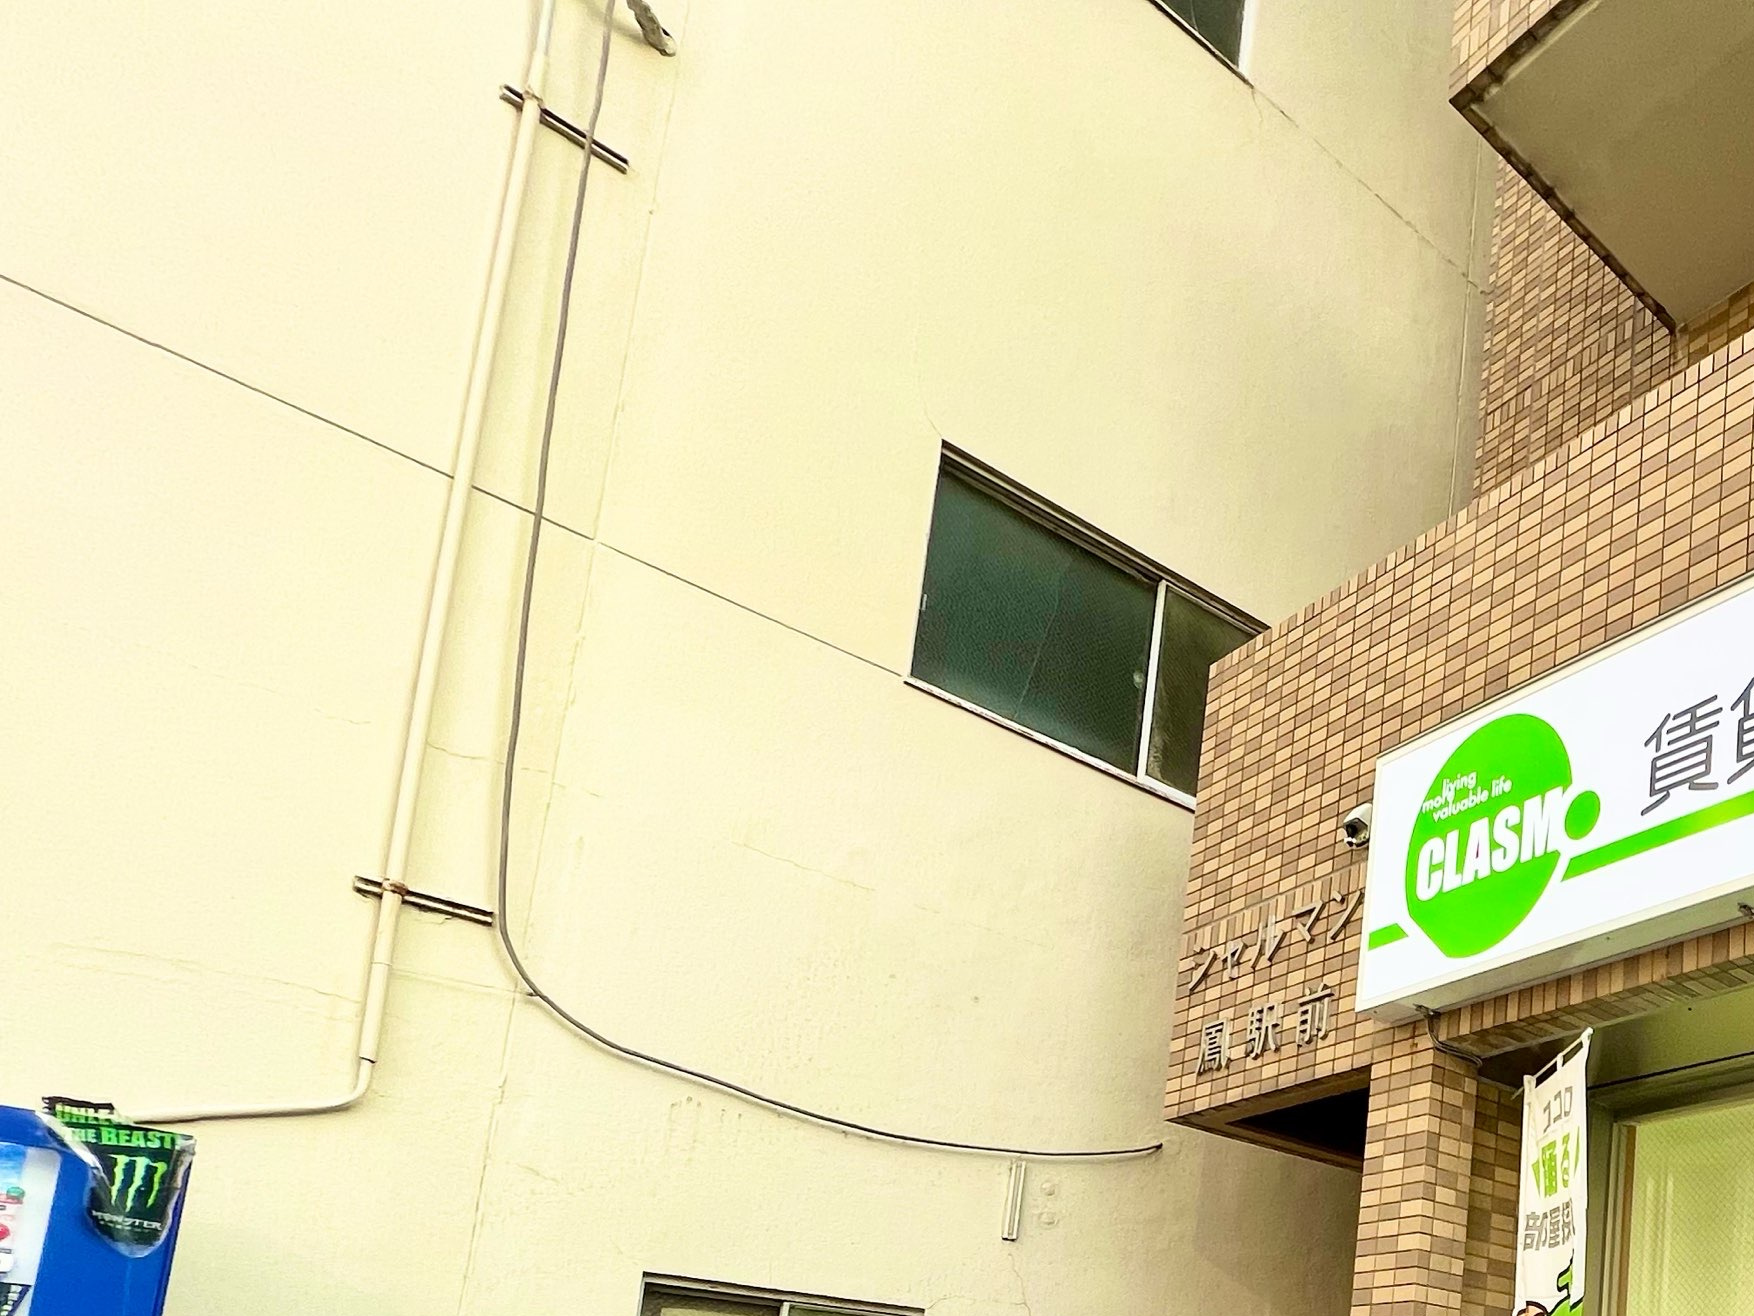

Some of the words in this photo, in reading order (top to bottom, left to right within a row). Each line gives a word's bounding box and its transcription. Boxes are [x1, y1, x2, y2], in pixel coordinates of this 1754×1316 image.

[1432, 787, 1489, 823] valuable
[1491, 775, 1513, 799] life
[1442, 771, 1477, 799] living
[1196, 982, 1336, 1077] 鳳駅前
